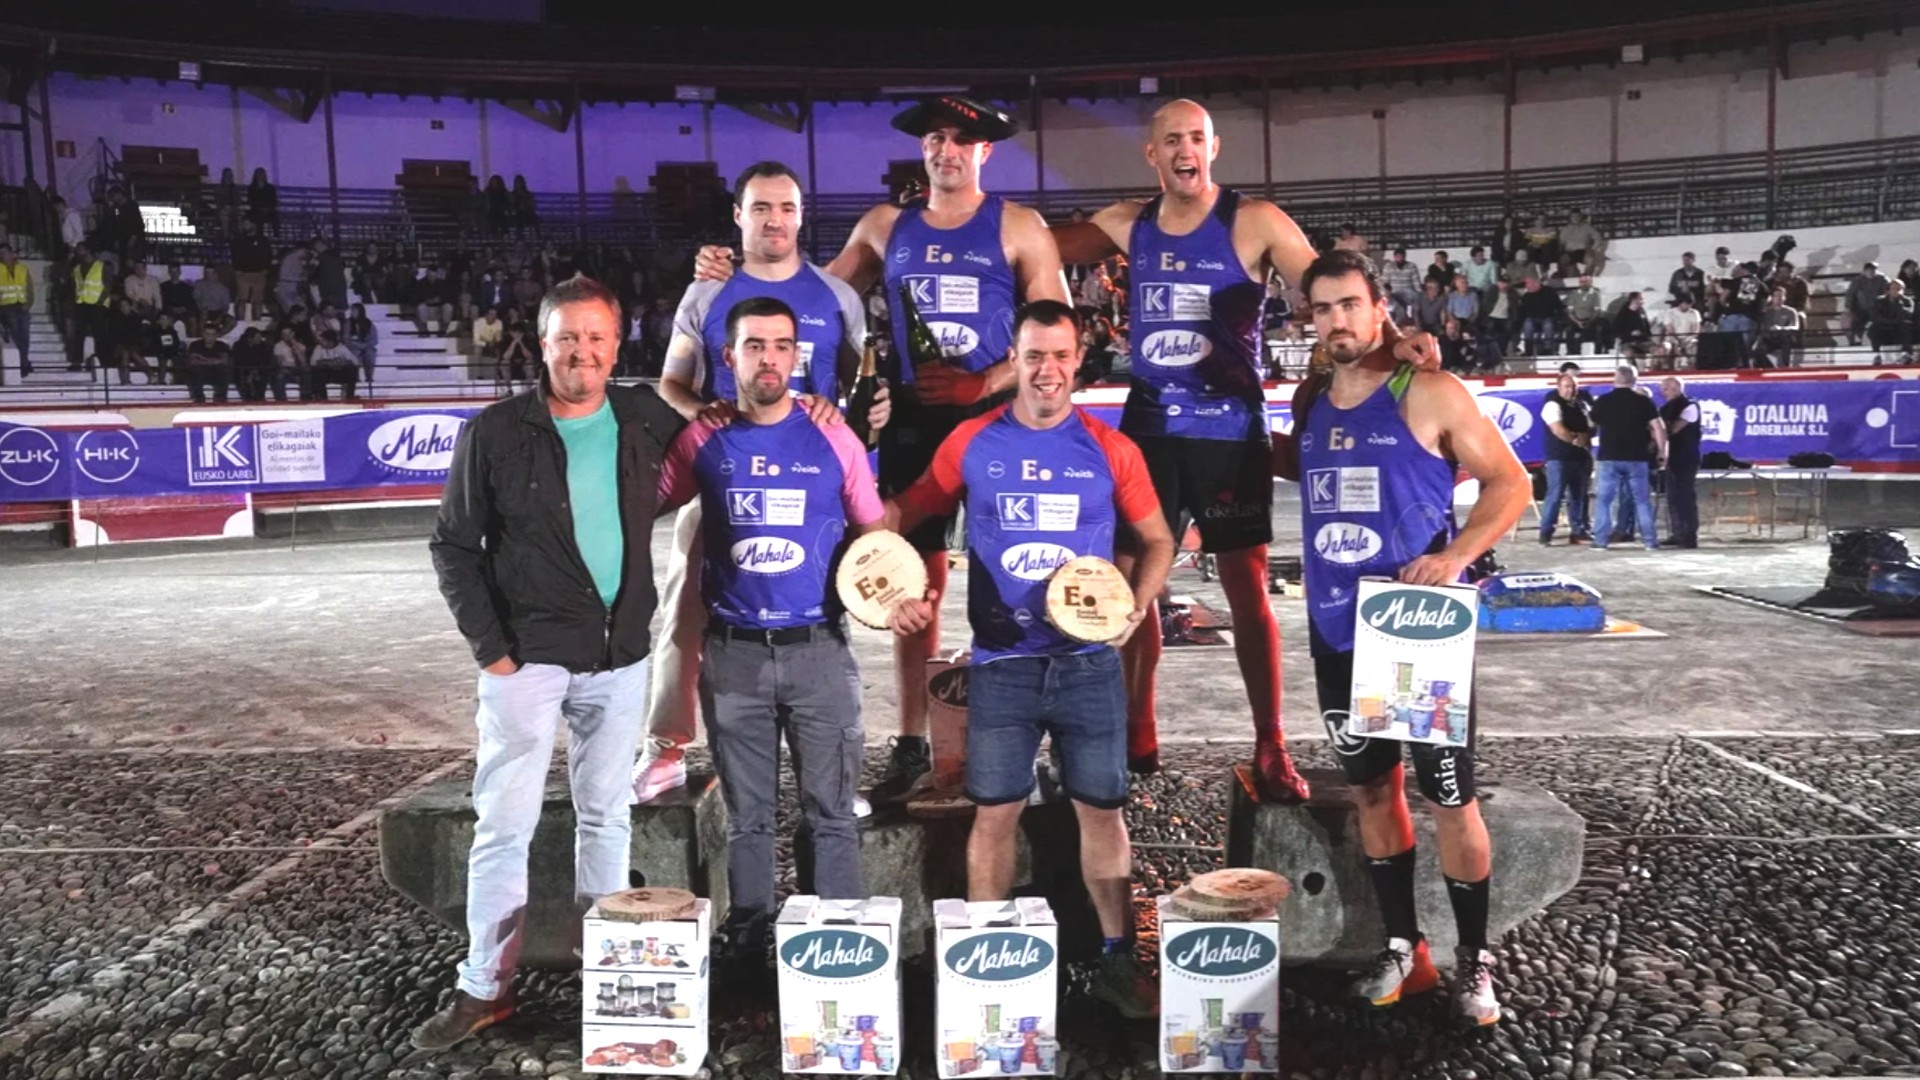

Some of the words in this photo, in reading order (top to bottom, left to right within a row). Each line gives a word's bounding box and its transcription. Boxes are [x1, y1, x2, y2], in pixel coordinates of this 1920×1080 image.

[935, 326, 969, 348] hala
[1147, 334, 1202, 359] Mahala
[1745, 404, 1829, 423] OTALUNA
[261, 429, 321, 439] Goi-mailako
[381, 421, 466, 461] Mahal
[194, 470, 225, 480] EUSKO
[227, 469, 255, 479] LABEL
[737, 542, 794, 566] Mahala
[1370, 596, 1458, 629] Mahala
[791, 935, 875, 969] Mahala
[955, 936, 1040, 974] Mahala
[1177, 933, 1262, 968] Mahala
